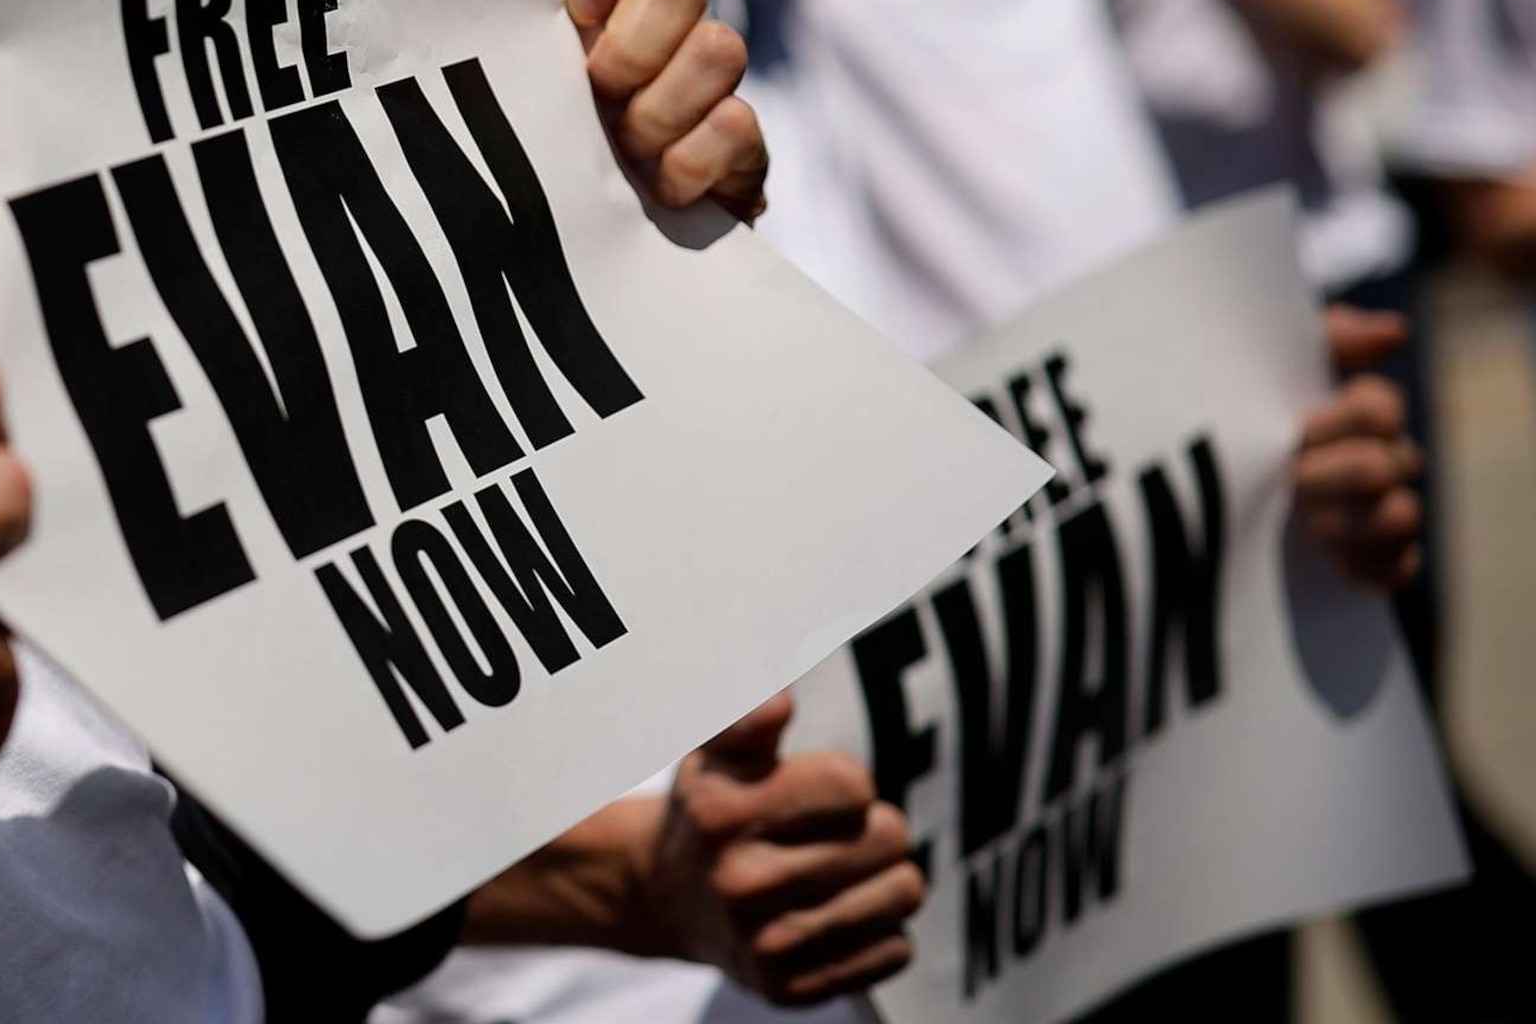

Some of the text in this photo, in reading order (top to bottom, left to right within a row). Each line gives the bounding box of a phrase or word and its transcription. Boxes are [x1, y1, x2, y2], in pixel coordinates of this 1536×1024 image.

[6, 56, 647, 622] EVAN
[312, 465, 630, 751] NOW
[851, 432, 1230, 894] EVAN
[956, 768, 1128, 1000] NOW
